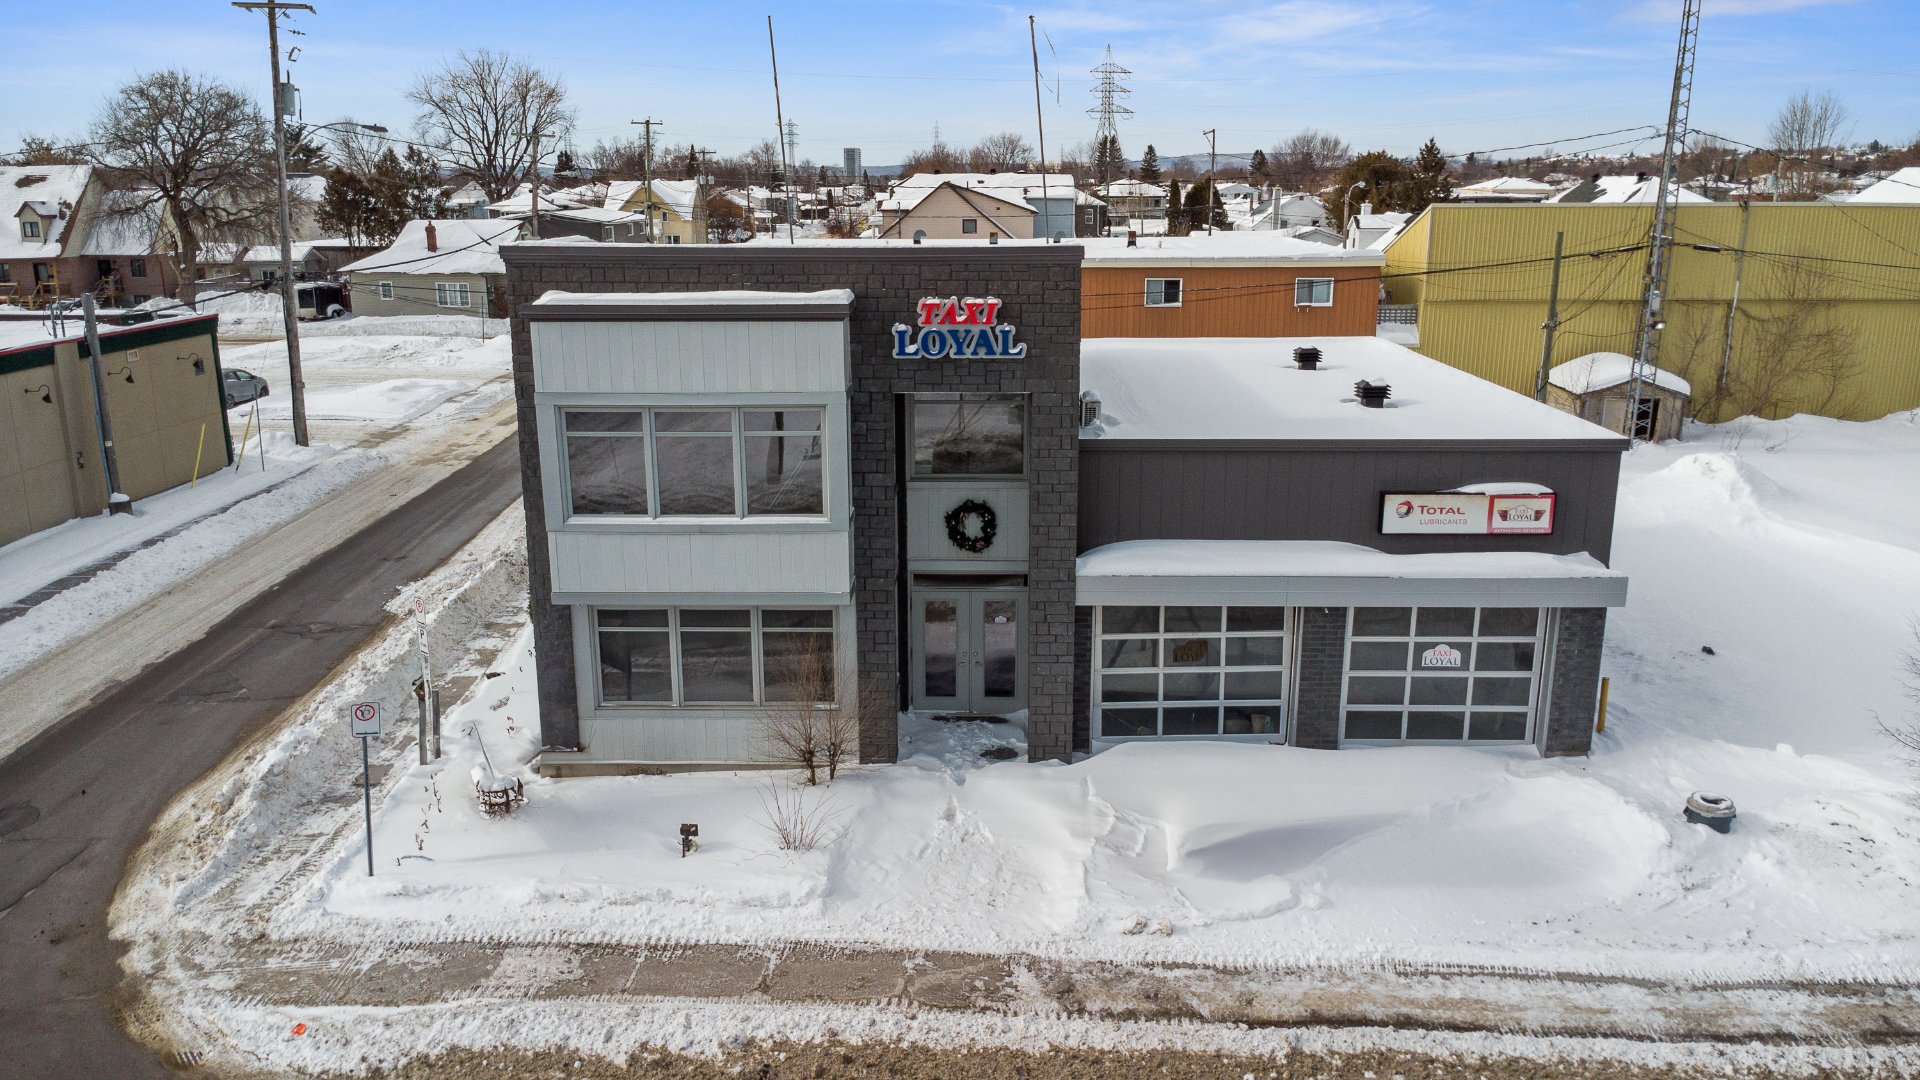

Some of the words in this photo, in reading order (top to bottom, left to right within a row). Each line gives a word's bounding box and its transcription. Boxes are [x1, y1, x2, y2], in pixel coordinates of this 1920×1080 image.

[918, 297, 1001, 326] TAXI
[893, 326, 1026, 358] LOYAL
[1417, 505, 1466, 515] TOTAL
[1508, 513, 1533, 521] LOYAL
[1432, 649, 1452, 657] TAXI
[1423, 656, 1460, 666] LOYAL
